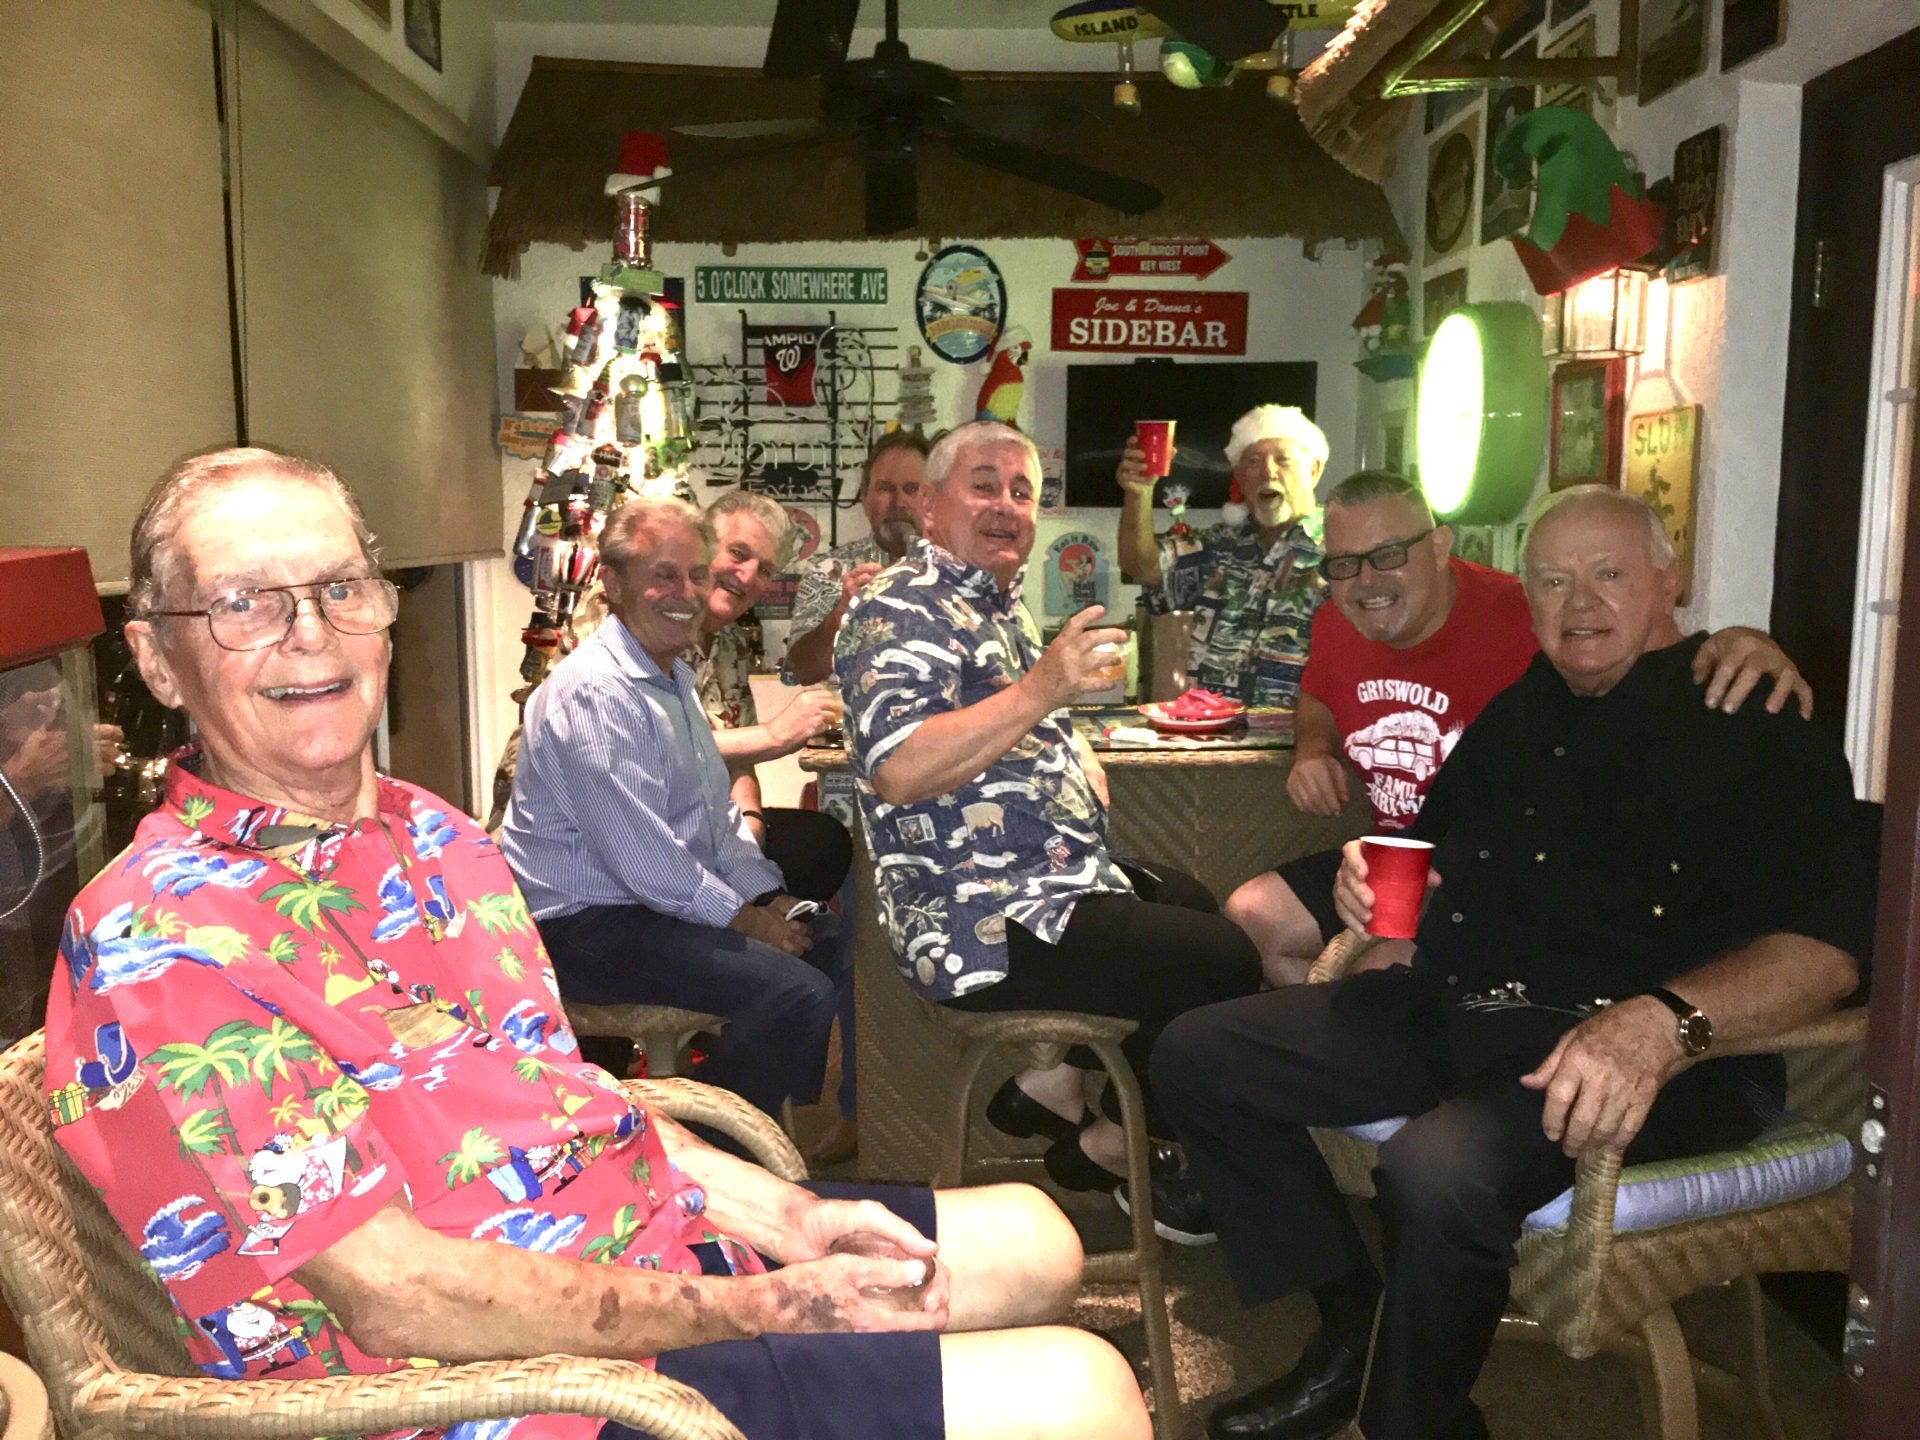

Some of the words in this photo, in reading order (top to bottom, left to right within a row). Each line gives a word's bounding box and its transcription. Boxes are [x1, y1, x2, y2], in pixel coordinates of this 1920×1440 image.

[1276, 4, 1320, 19] TLE
[1074, 15, 1138, 37] ISLAND
[697, 271, 706, 299] 5
[710, 271, 766, 299] O'CLOCK
[771, 271, 856, 300] SOMEWHERE
[860, 272, 886, 300] AVE
[1093, 297, 1120, 315] Joe
[1125, 298, 1137, 313] &
[1144, 298, 1203, 314] Donna's
[1068, 316, 1228, 348] SIDEBAR
[1357, 678, 1450, 715] GRISWOLD
